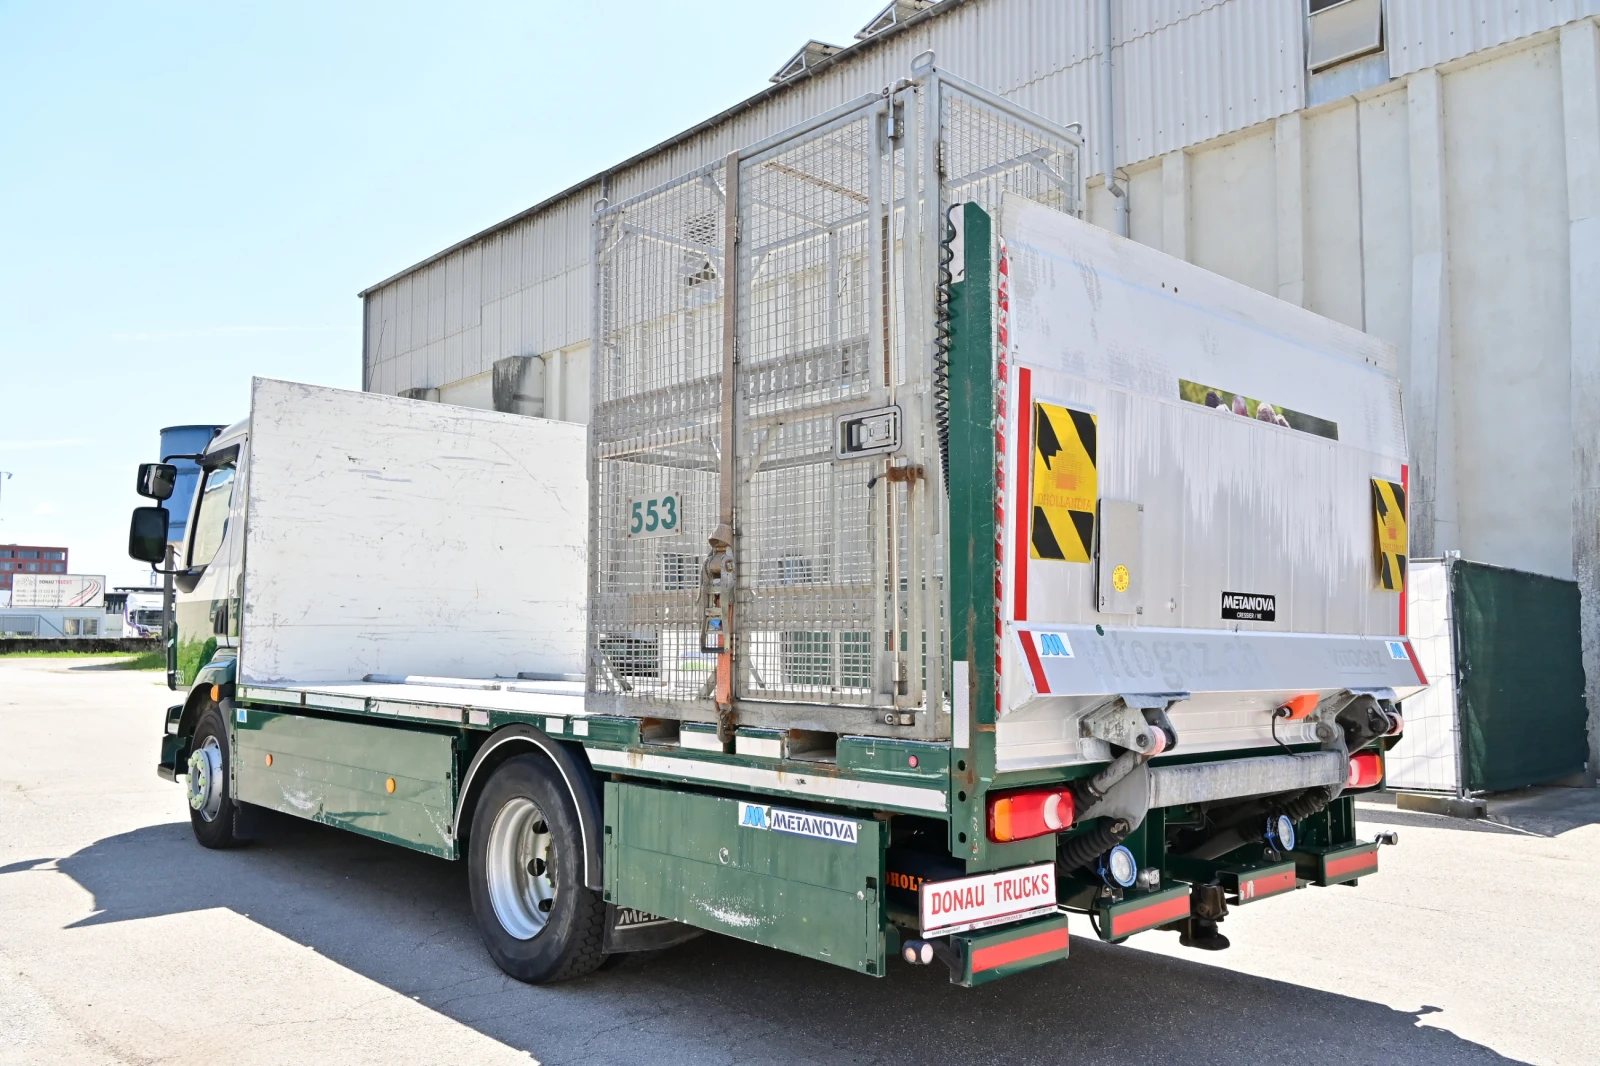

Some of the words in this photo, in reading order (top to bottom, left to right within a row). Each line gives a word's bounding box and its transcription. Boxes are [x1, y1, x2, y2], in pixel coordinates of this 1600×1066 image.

[630, 496, 677, 534] 553
[1037, 493, 1092, 512] DHOLLANDIA
[1222, 595, 1275, 611] METANOVA
[773, 812, 856, 841] METANOVA
[931, 884, 985, 915] DONAU
[993, 873, 1049, 903] TRUCKS
